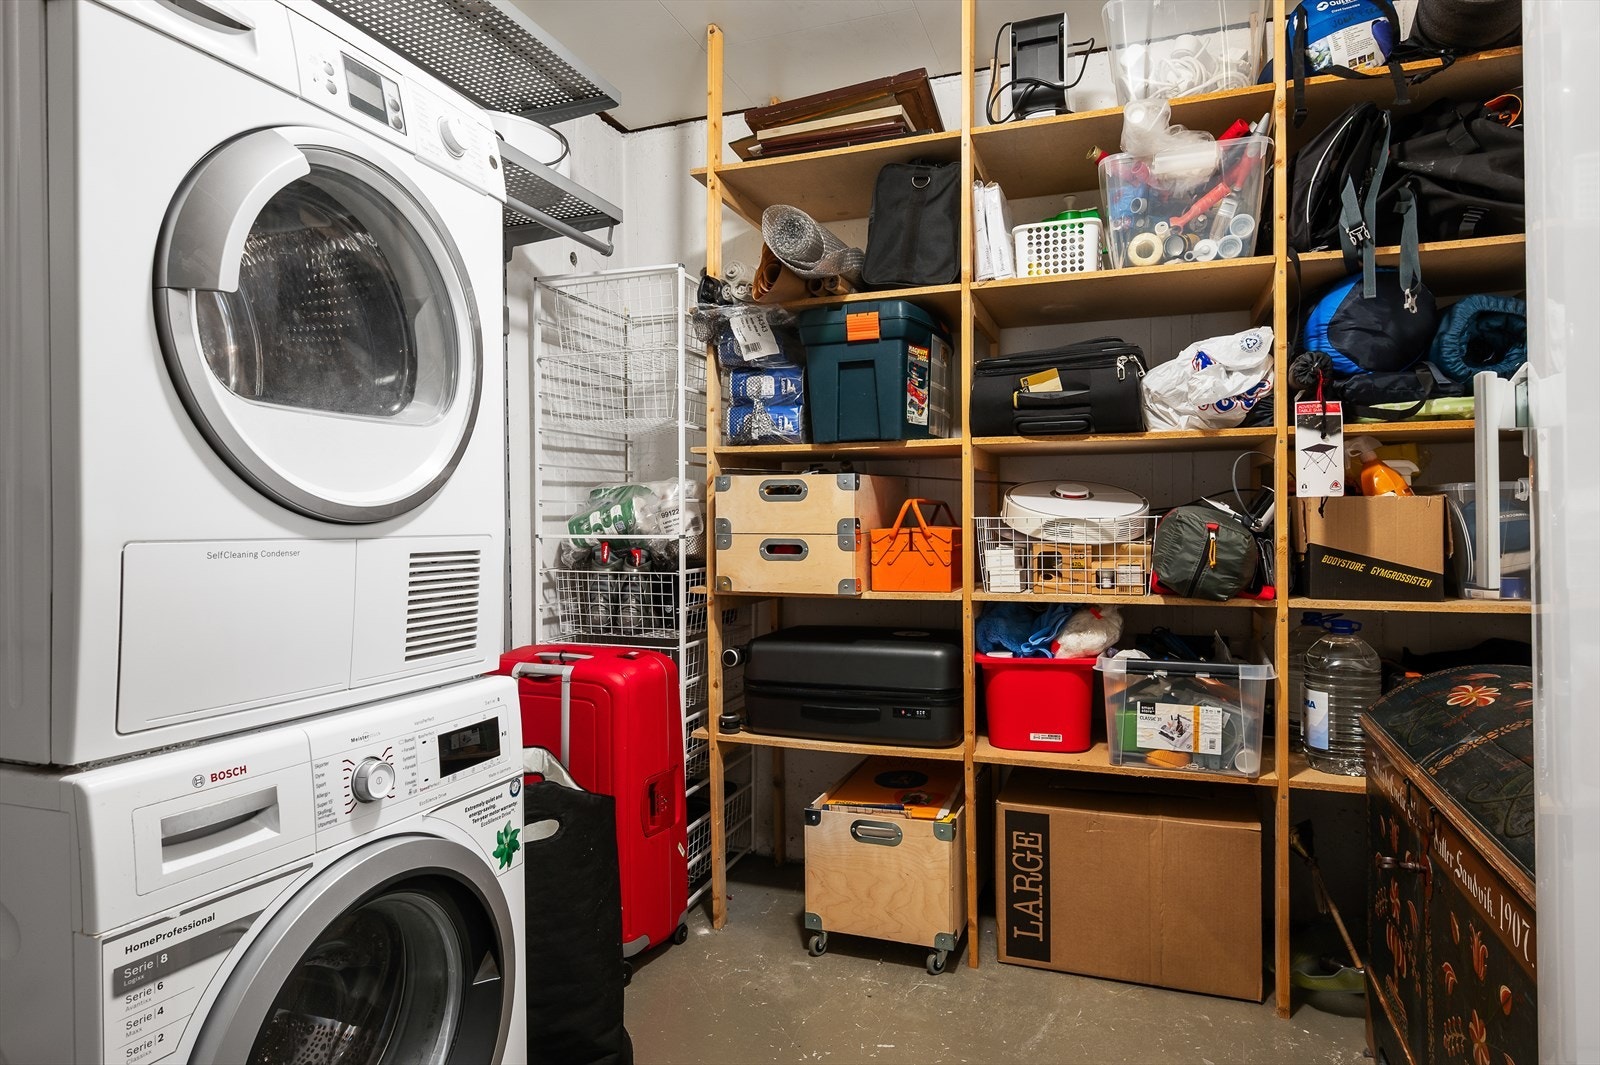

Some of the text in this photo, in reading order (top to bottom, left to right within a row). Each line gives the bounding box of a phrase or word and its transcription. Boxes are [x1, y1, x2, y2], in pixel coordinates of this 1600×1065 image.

[206, 549, 300, 560] SelfCleaning Condenser
[1321, 554, 1366, 572] BODYSTORE
[1370, 566, 1433, 588] GYMGROSSISTEN
[210, 765, 247, 783] BOSCH
[464, 801, 485, 813] Extremely
[485, 796, 495, 806] quiet
[489, 808, 500, 817] motor
[1012, 830, 1044, 942] LARGE
[125, 913, 216, 955] HomeProfessional
[1500, 894, 1535, 968] 1907.
[124, 953, 168, 979] Serie 8
[123, 974, 145, 987] Logixx
[125, 982, 164, 1005] Serie 6
[126, 1006, 164, 1031] Serie 4
[126, 1033, 165, 1058] Serie 2
